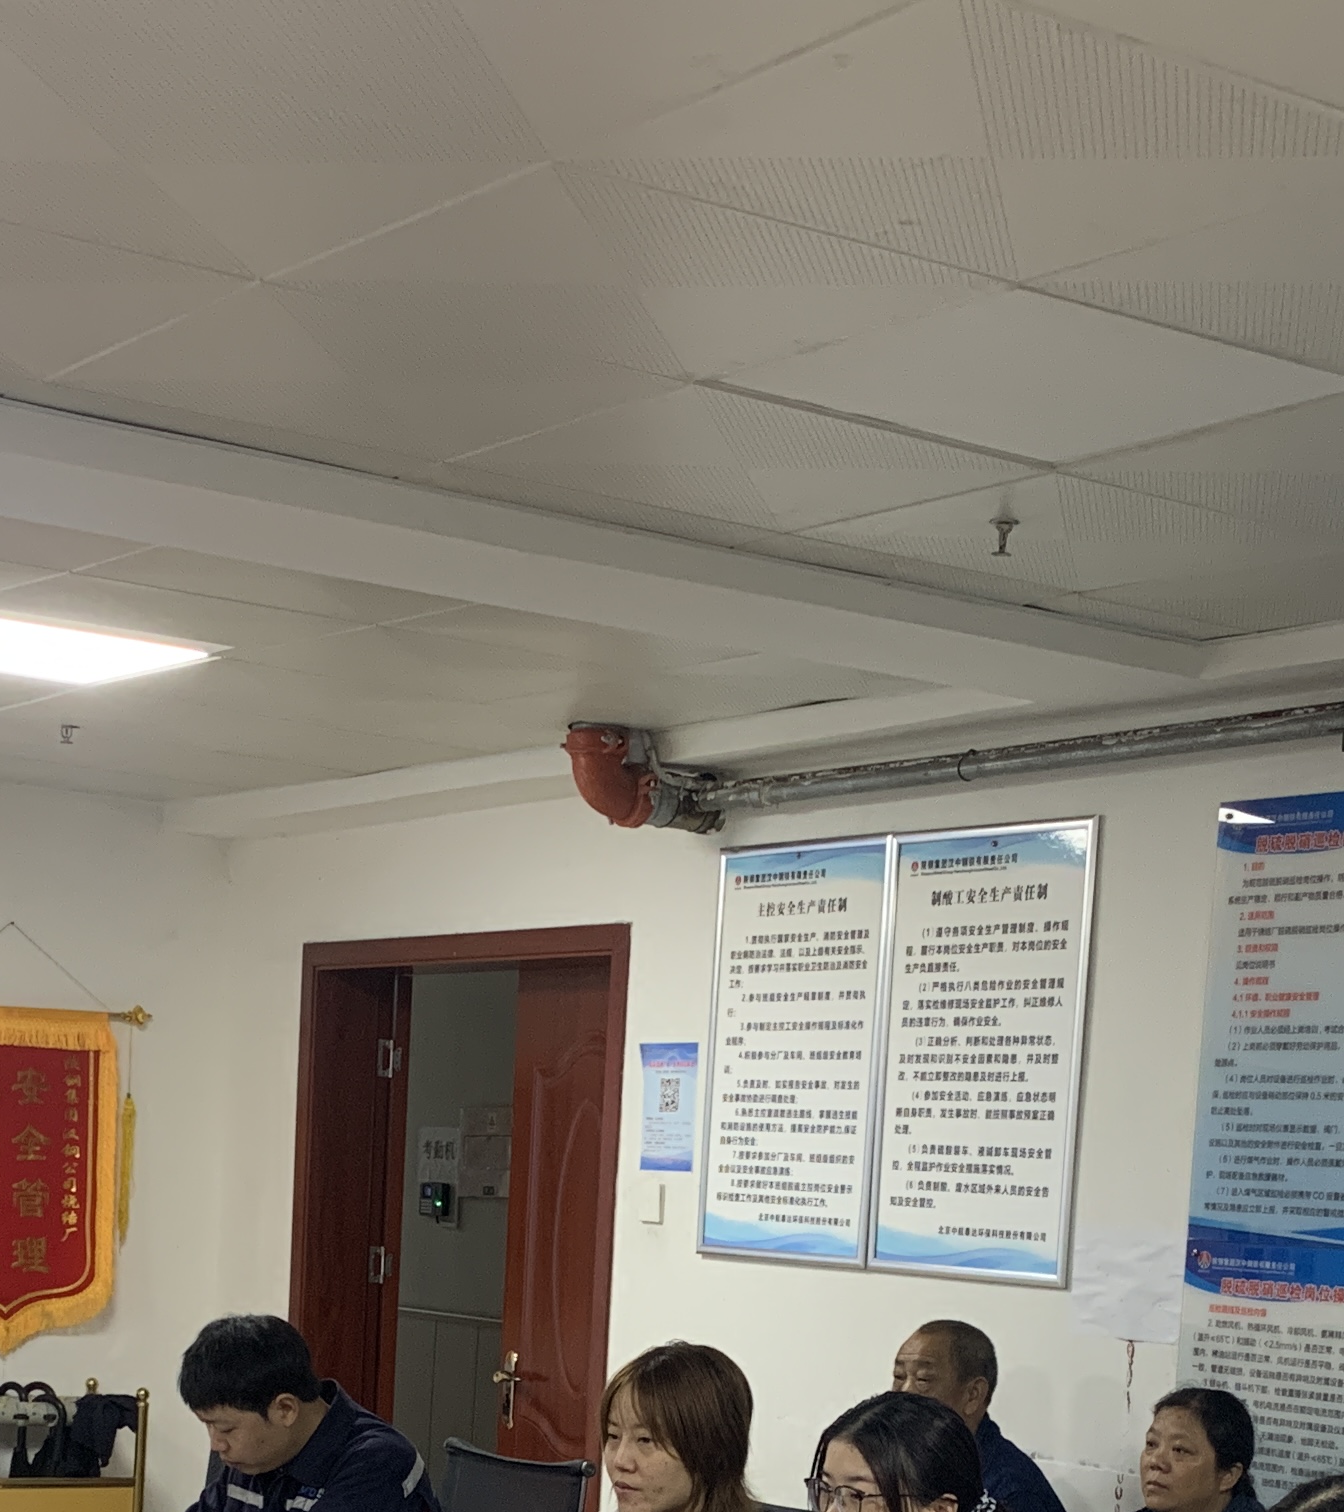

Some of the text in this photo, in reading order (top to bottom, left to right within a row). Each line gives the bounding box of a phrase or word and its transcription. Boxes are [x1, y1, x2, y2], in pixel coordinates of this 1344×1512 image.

[931, 883, 1048, 906] 制酸工安全生产责任制
[757, 897, 848, 918] 主控安全生产责任制
[11, 1067, 52, 1274] 安全管理
